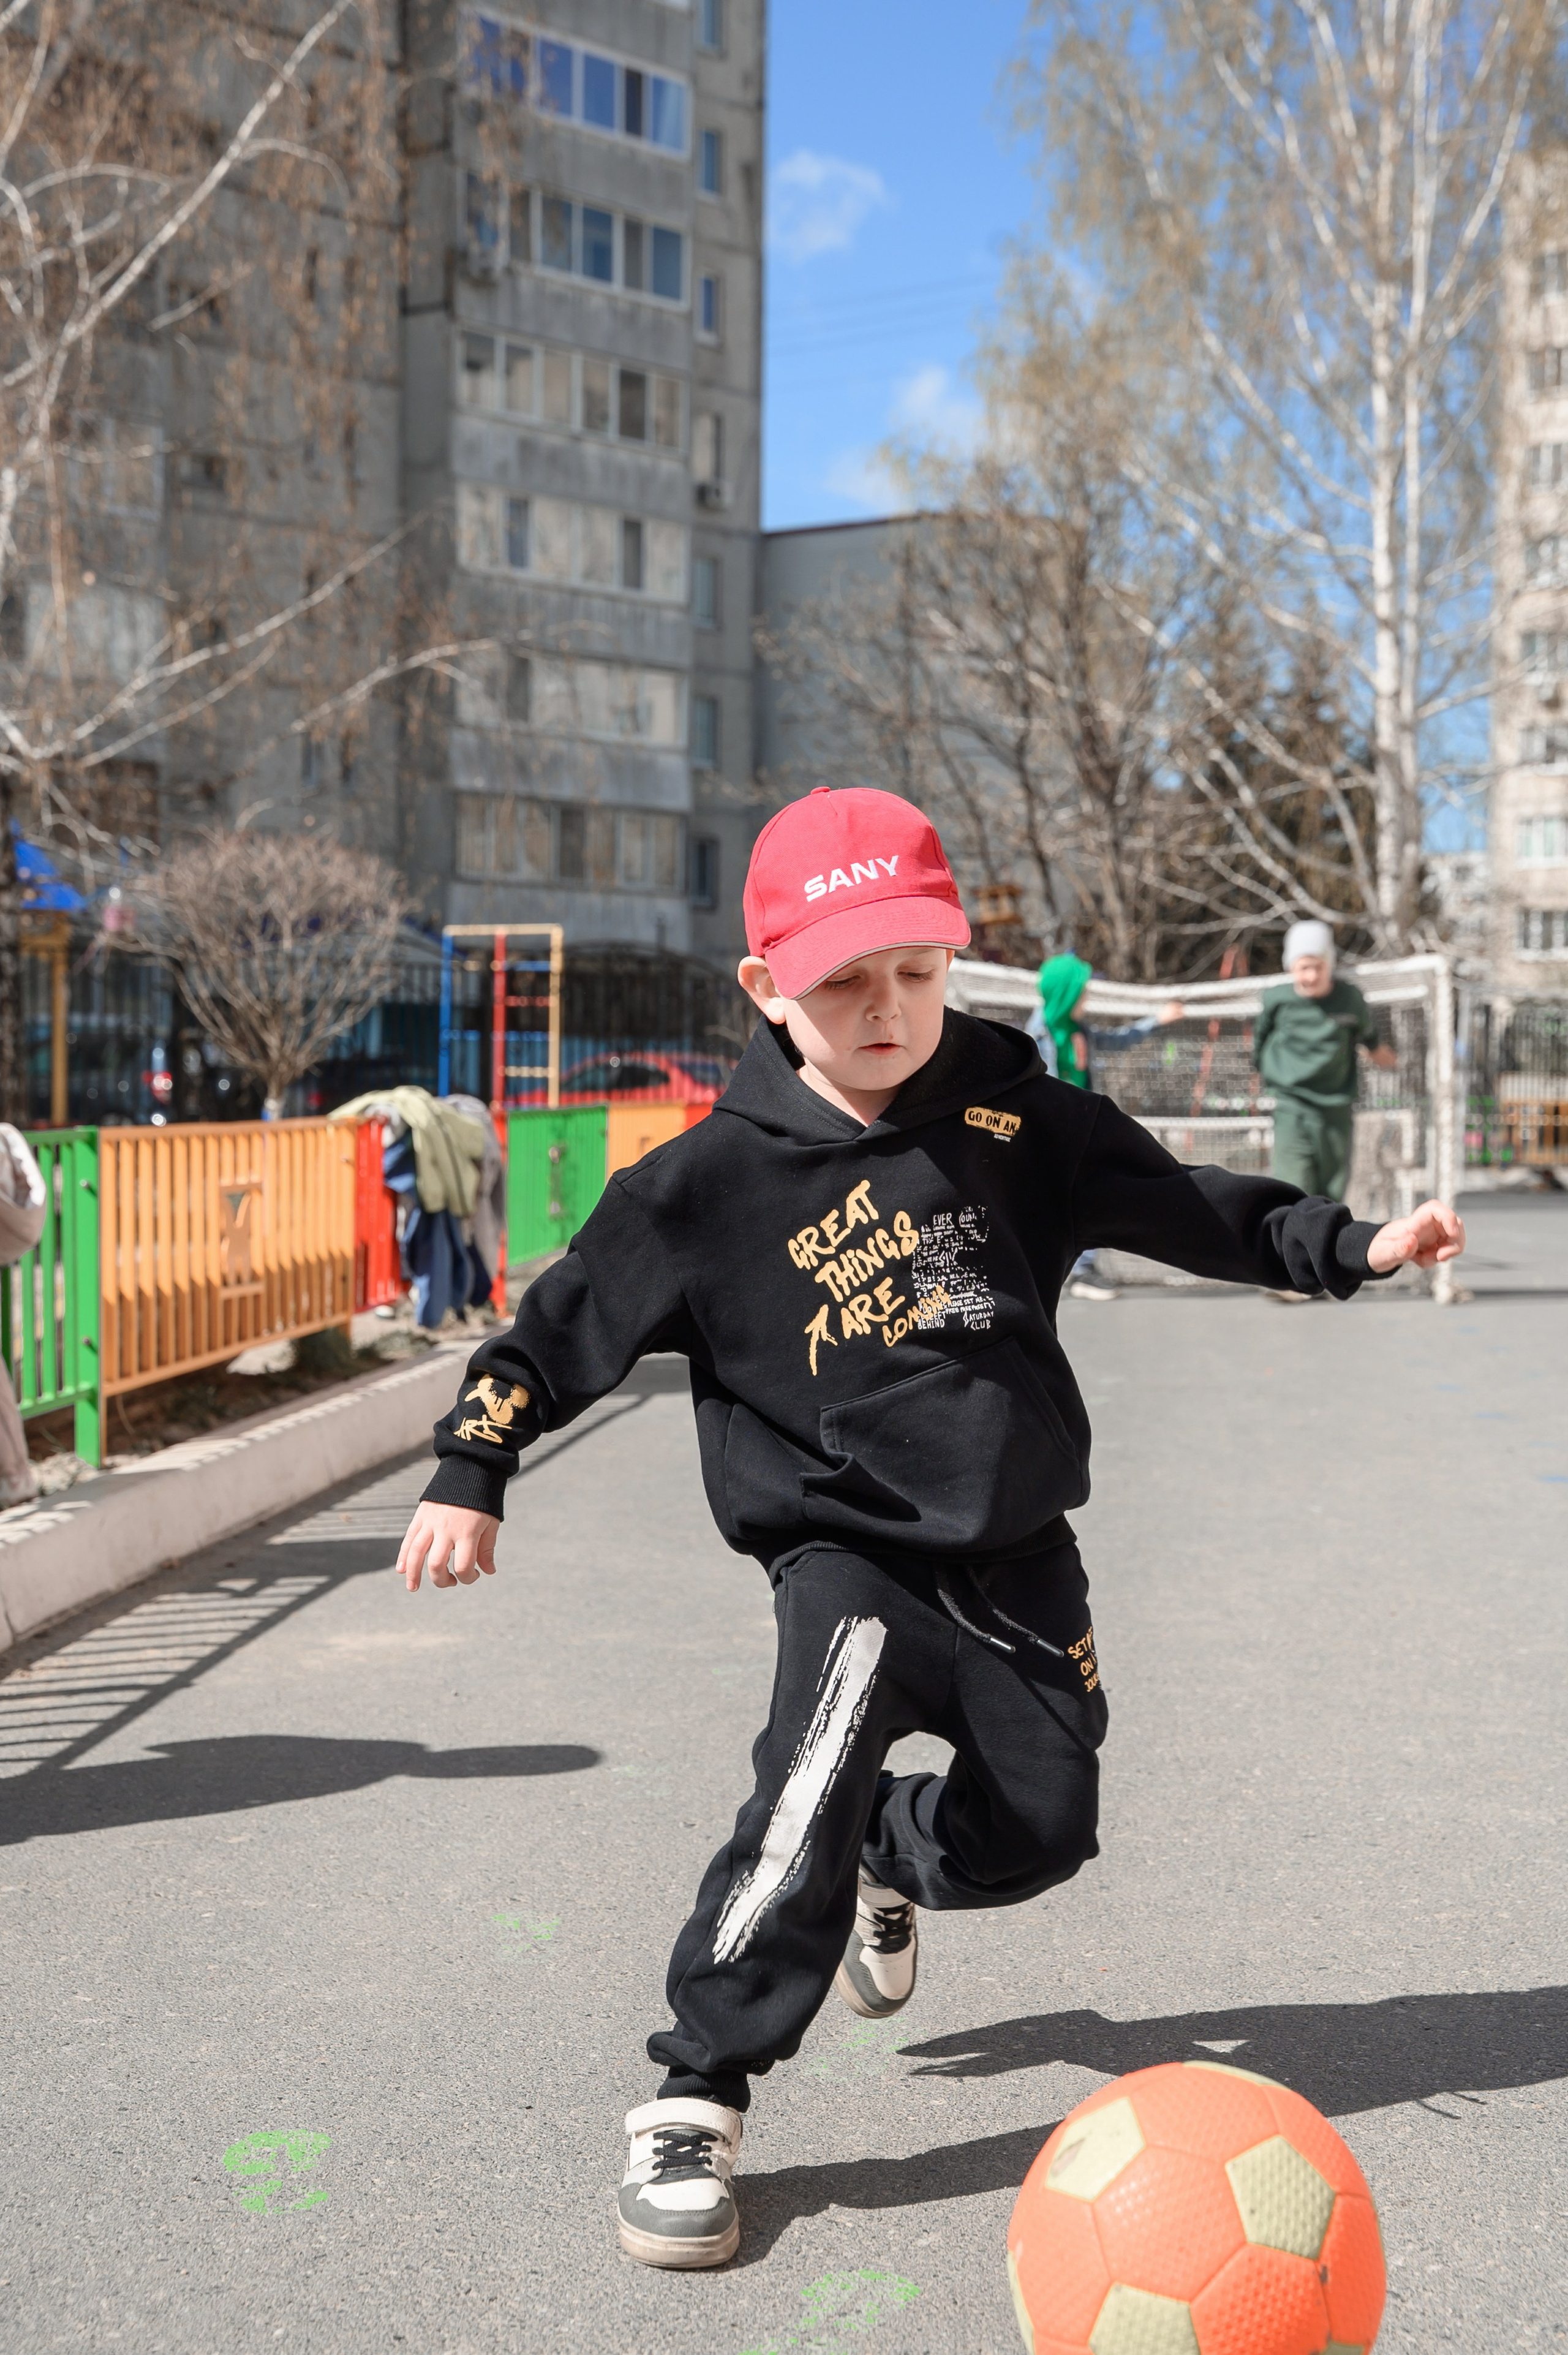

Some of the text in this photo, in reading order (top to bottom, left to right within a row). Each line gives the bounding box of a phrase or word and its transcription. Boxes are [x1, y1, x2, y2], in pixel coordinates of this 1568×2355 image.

[804, 855, 899, 902] SANY
[968, 1111, 1017, 1134] GO ON AN
[788, 1179, 879, 1270] GREAT
[933, 1212, 953, 1226] EVER
[815, 1211, 919, 1302] THINGS
[840, 1276, 906, 1339] ARE
[882, 1285, 954, 1347] COMING
[962, 1310, 994, 1328] SATURDAY
[970, 1319, 992, 1331] CLUB
[1068, 1638, 1088, 1660] SET
[1080, 1657, 1095, 1676] ON
